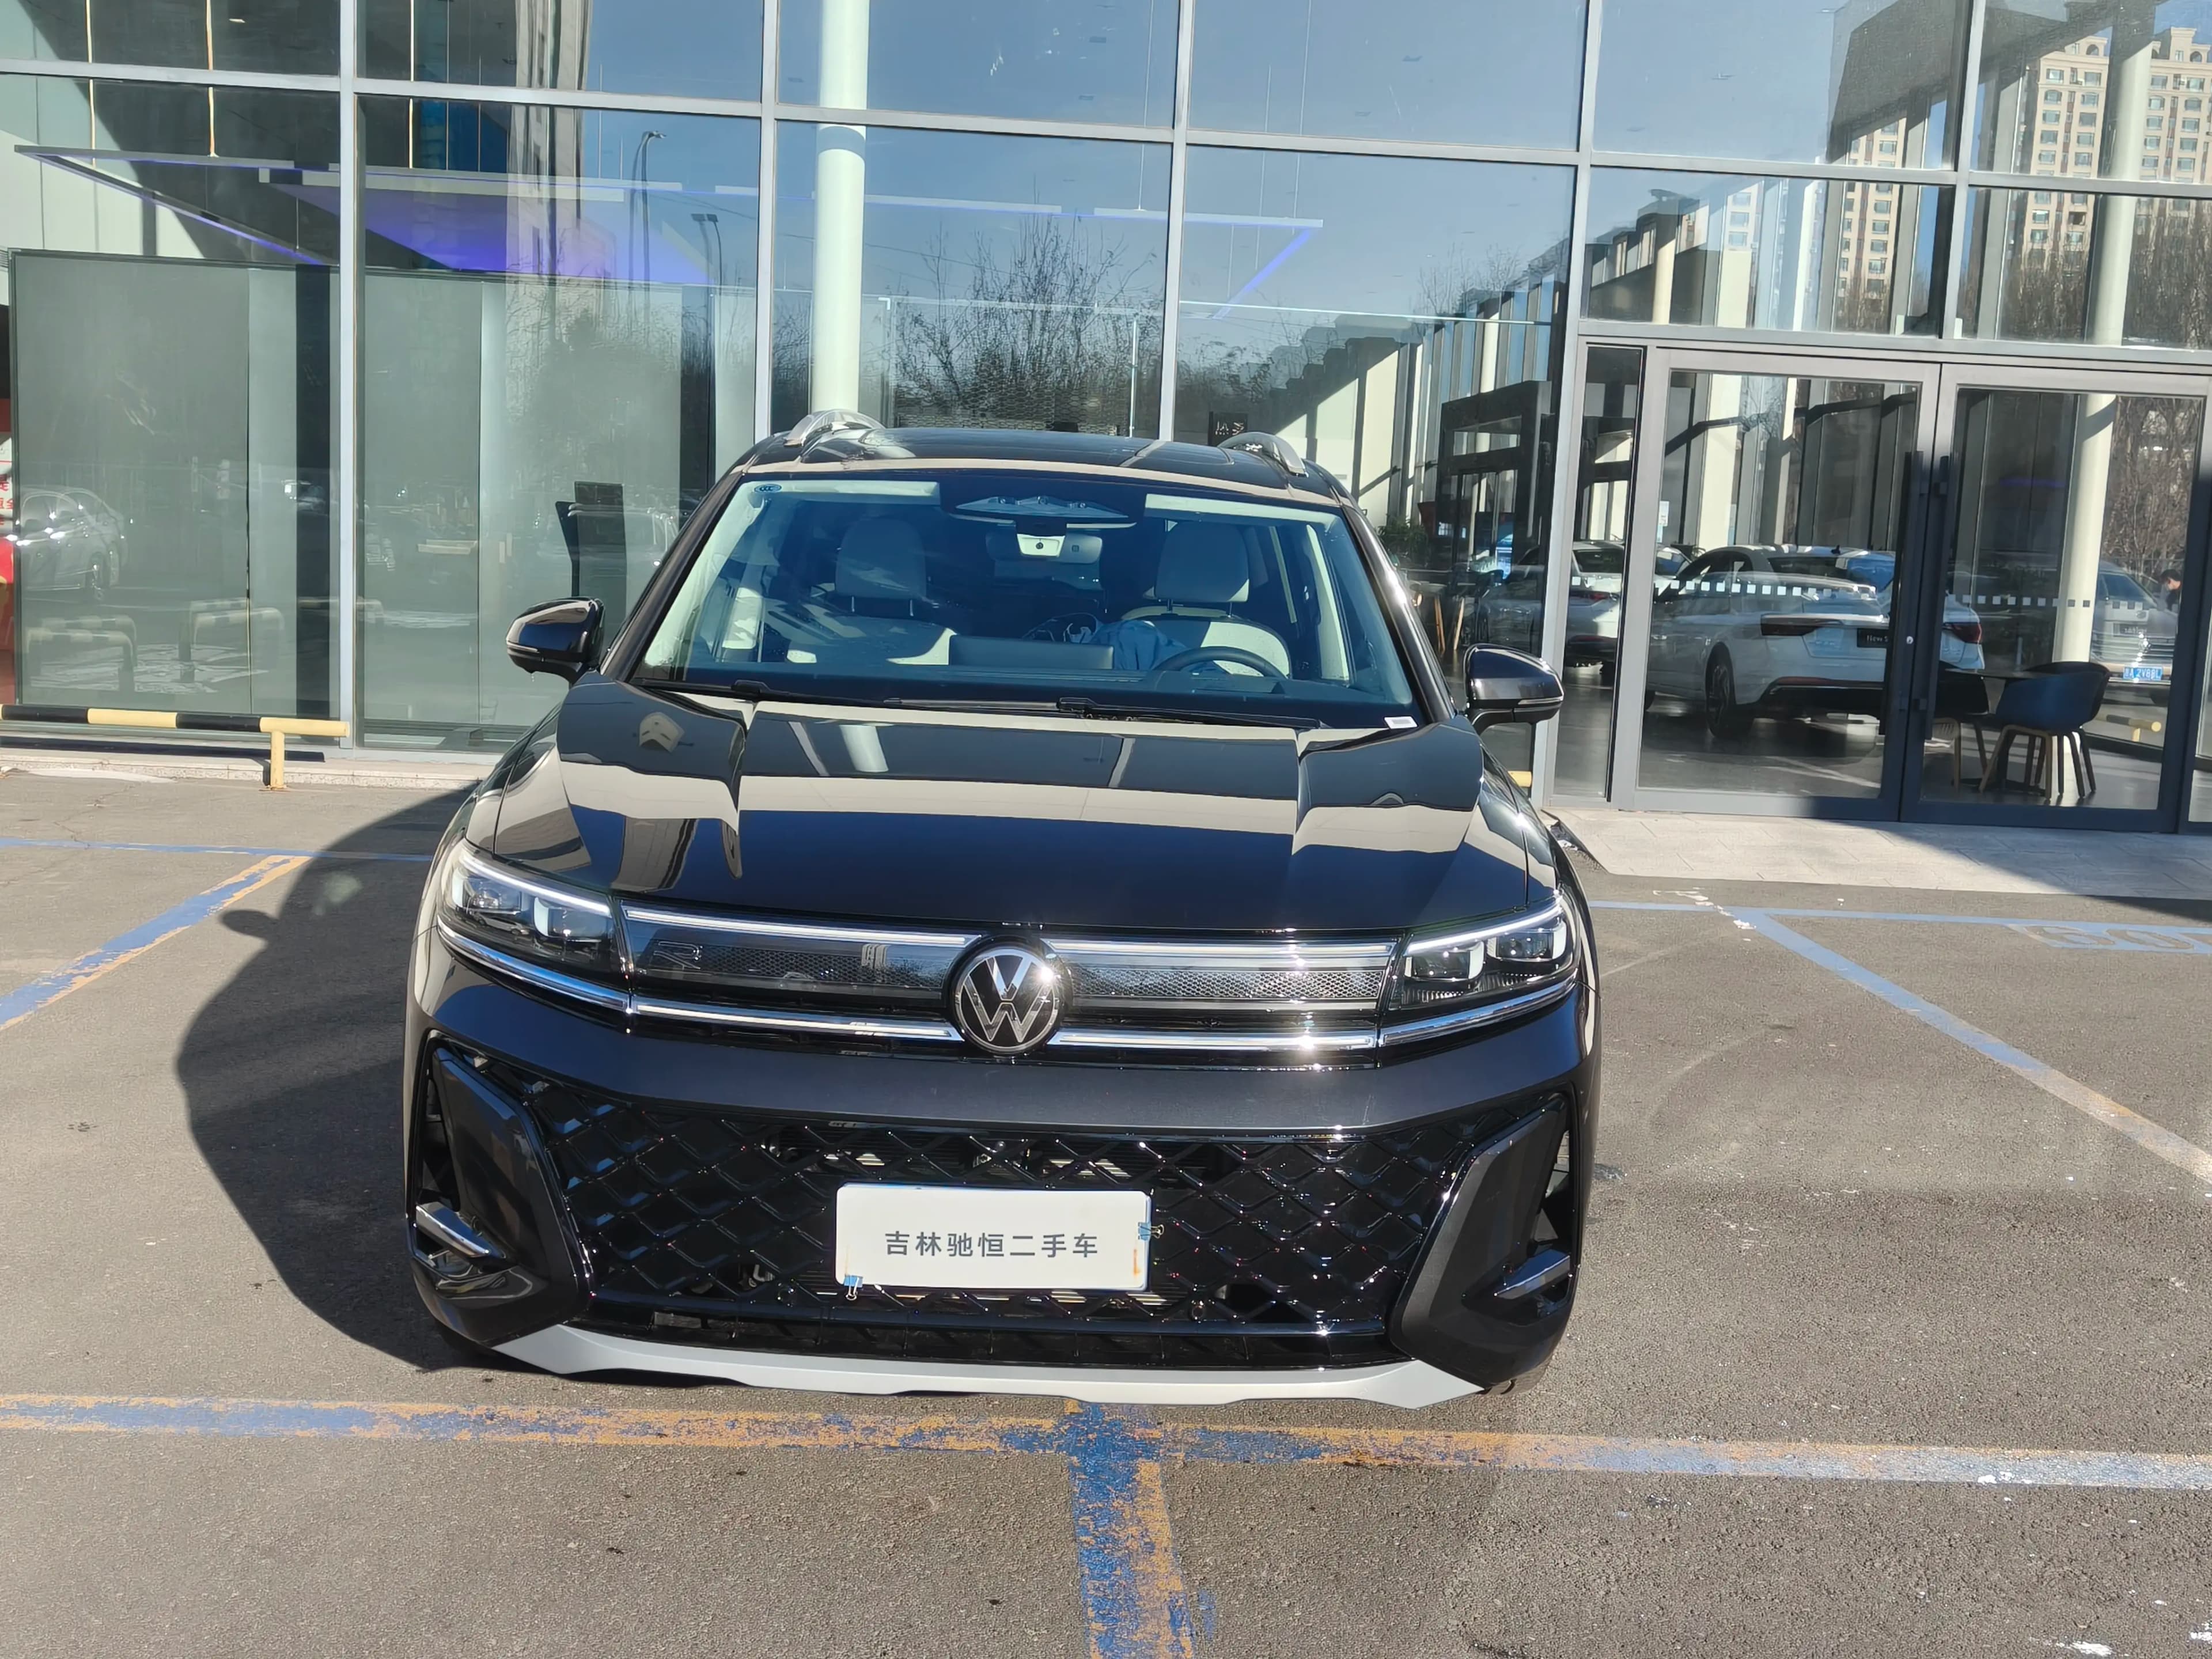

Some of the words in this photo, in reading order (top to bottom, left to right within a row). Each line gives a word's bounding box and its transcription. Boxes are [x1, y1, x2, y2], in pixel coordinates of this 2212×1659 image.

[885, 1230, 1097, 1258] 吉林驰恒二手车
